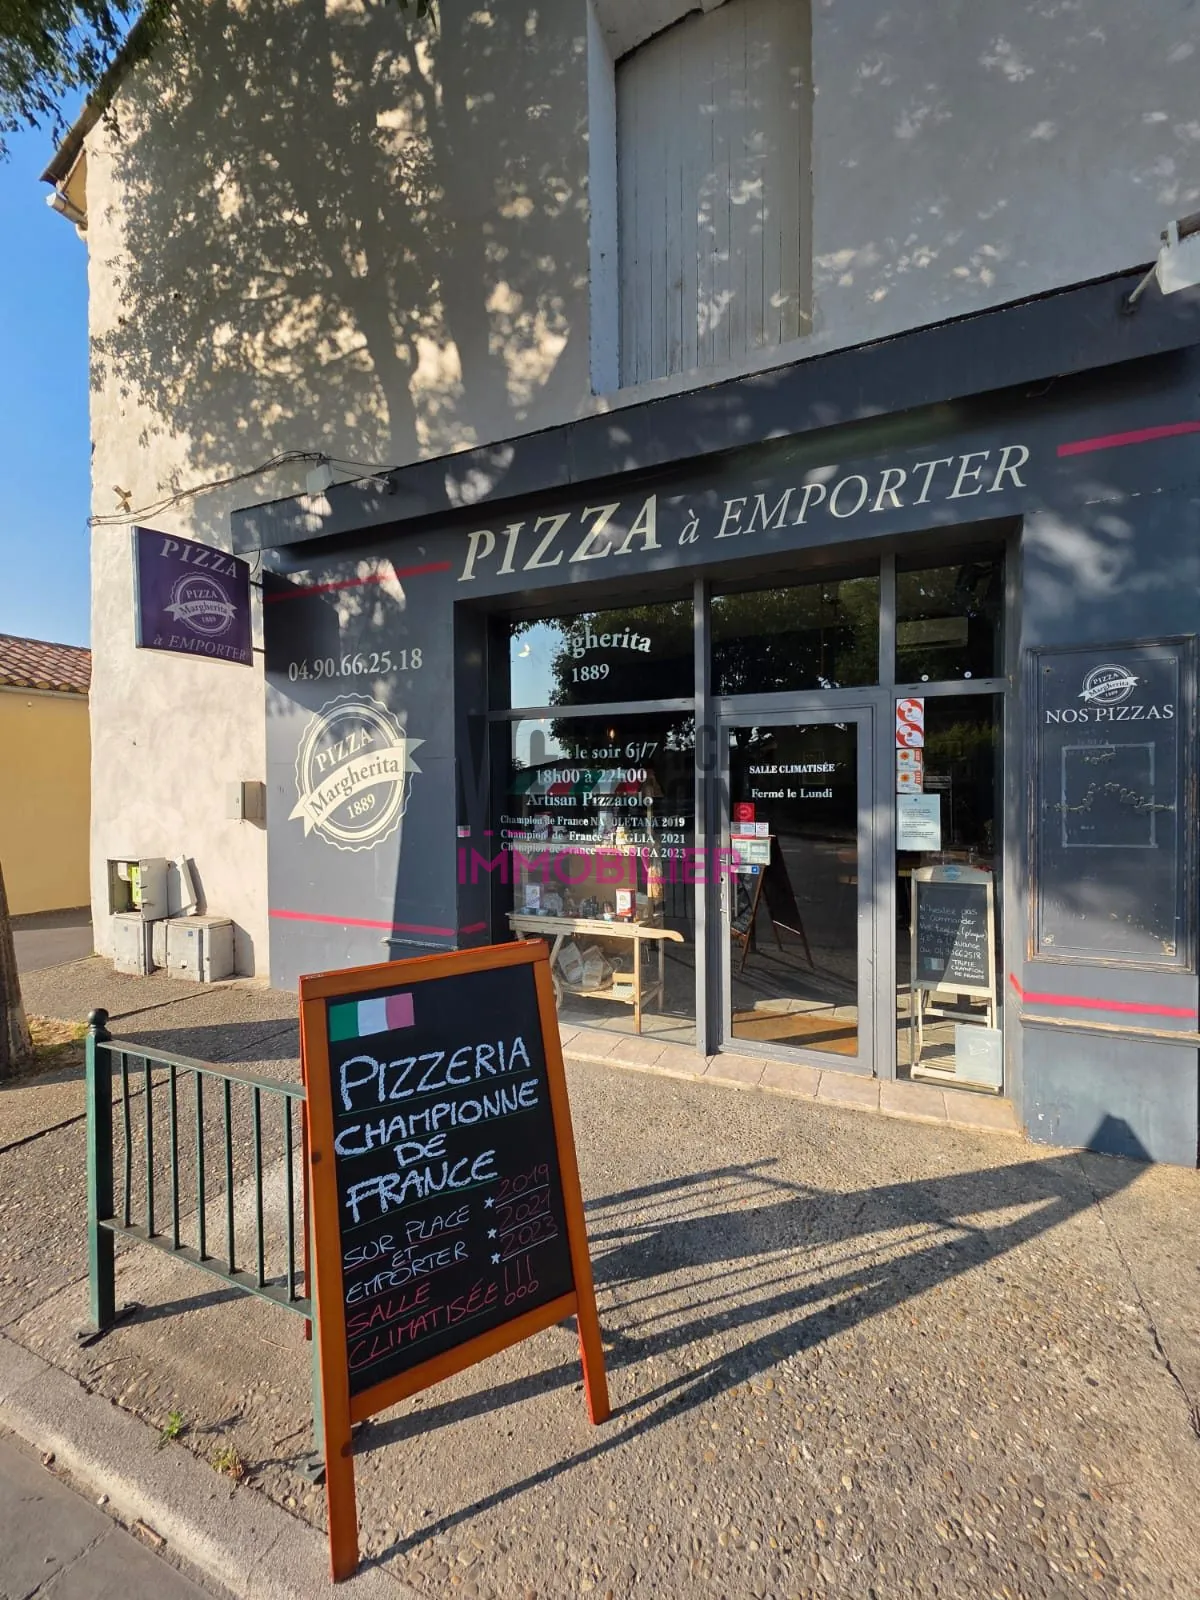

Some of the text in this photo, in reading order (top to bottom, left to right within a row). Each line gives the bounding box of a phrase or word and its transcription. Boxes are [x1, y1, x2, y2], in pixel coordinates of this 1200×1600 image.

[457, 445, 1031, 581] PIZZA à EMPORTER
[160, 538, 238, 579] PIZZA
[178, 601, 229, 616] Margherita
[185, 589, 218, 599] PIZZA
[153, 634, 247, 661] à EMPORTER
[288, 648, 423, 682] 04.90.66.25.18
[572, 663, 610, 683] 1889
[1093, 672, 1119, 684] PIZZA
[1045, 704, 1175, 724] NOS PIZZAS
[315, 727, 375, 773] PIZZA
[575, 744, 588, 760] le
[592, 744, 621, 760] soir
[625, 740, 658, 763] 6j/7
[536, 767, 647, 784] 18h00 à 22h00
[749, 762, 836, 774] SALLE CLIMATISÉE
[309, 756, 401, 817] Margherita
[525, 792, 654, 808] Artisan Pizzaiolo
[751, 788, 833, 798] Fermé le Lundi
[346, 793, 376, 820] 1889
[500, 814, 544, 827] Champion
[558, 816, 588, 826] France
[662, 817, 686, 827] 2019
[500, 829, 545, 842] Champion
[569, 831, 603, 842] France
[661, 833, 686, 844] 2021
[661, 848, 687, 858] 2023
[340, 1036, 531, 1111] PIZZERIA
[334, 1078, 539, 1156] CHAMPIONNE
[393, 1132, 447, 1167] DE
[346, 1150, 498, 1223] FRANCE
[498, 1163, 550, 1200] 2019
[496, 1188, 551, 1232] 2021
[344, 1203, 471, 1270] SUR PLACE
[499, 1215, 558, 1258] 2023
[346, 1240, 469, 1304] EMPORTER
[391, 1245, 419, 1269] ET
[347, 1282, 431, 1338] SALLE
[349, 1278, 498, 1370] CLIMATISÉE
